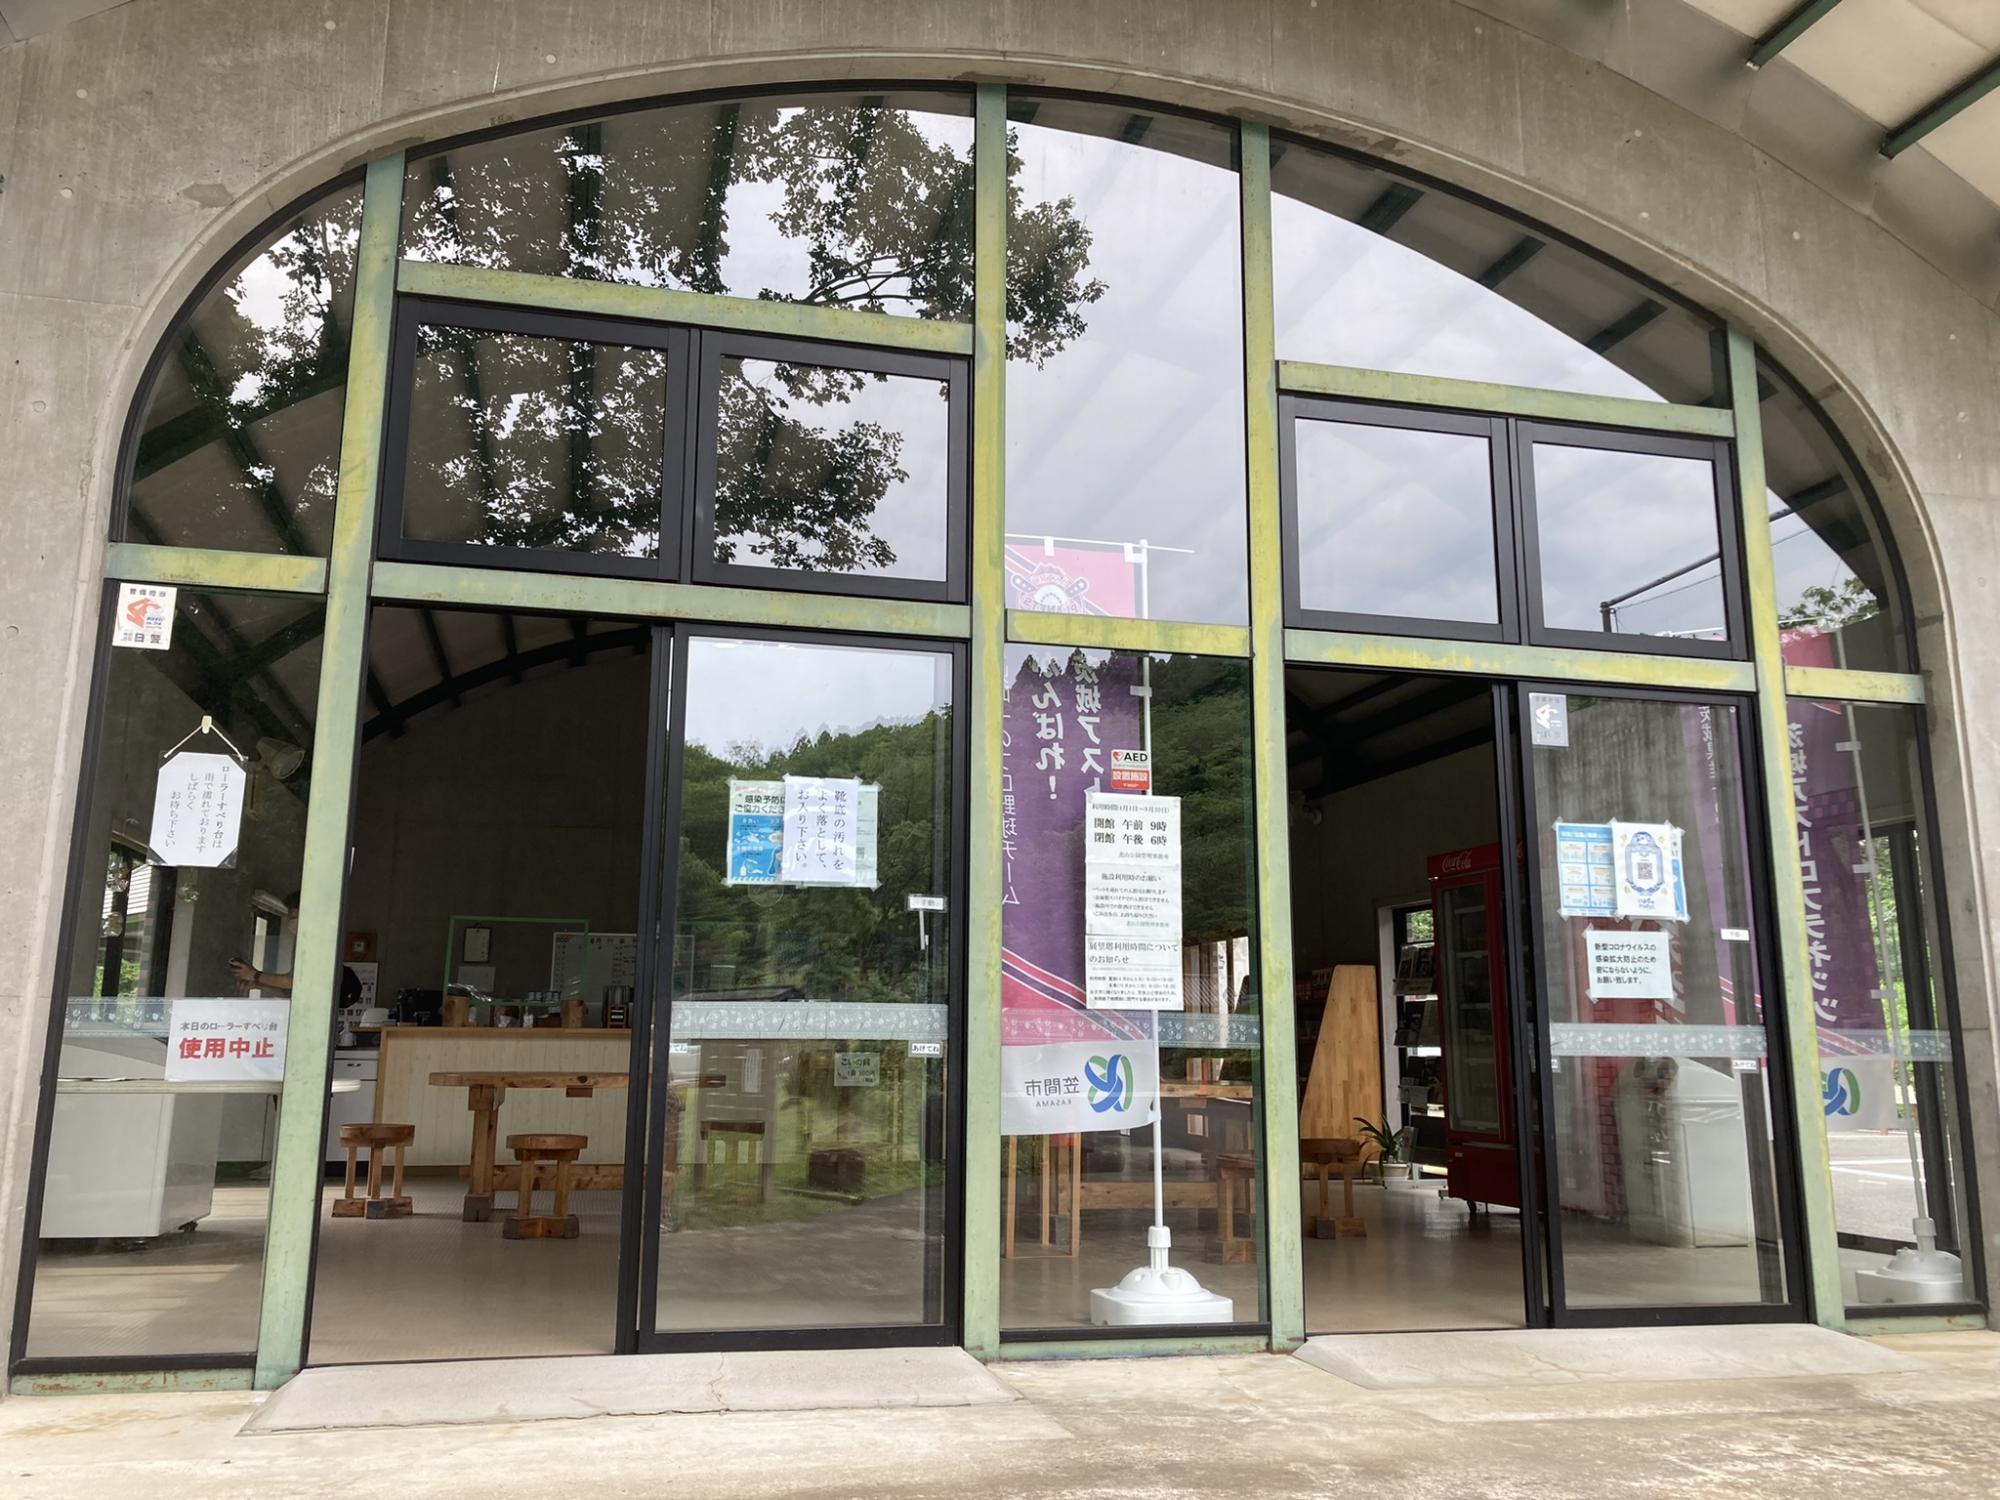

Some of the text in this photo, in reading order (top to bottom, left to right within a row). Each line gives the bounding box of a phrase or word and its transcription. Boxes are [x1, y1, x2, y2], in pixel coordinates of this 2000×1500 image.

[1124, 752, 1148, 762] AED
[165, 791, 181, 848] お待ち下さい
[1094, 817, 1167, 832] 開館 午前 9時
[832, 790, 847, 871] 靴底の汚れを
[1094, 832, 1167, 846] 閉館 午後 6時
[1595, 943, 1657, 951] 新型コロナウイルスの
[1089, 956, 1129, 964] のお知らせ
[1595, 955, 1657, 964] 感染拡大防止のため
[180, 1022, 278, 1032] 本日のローラーすべり台
[179, 1037, 275, 1059] 使用中止
[911, 1044, 940, 1053] あけてね
